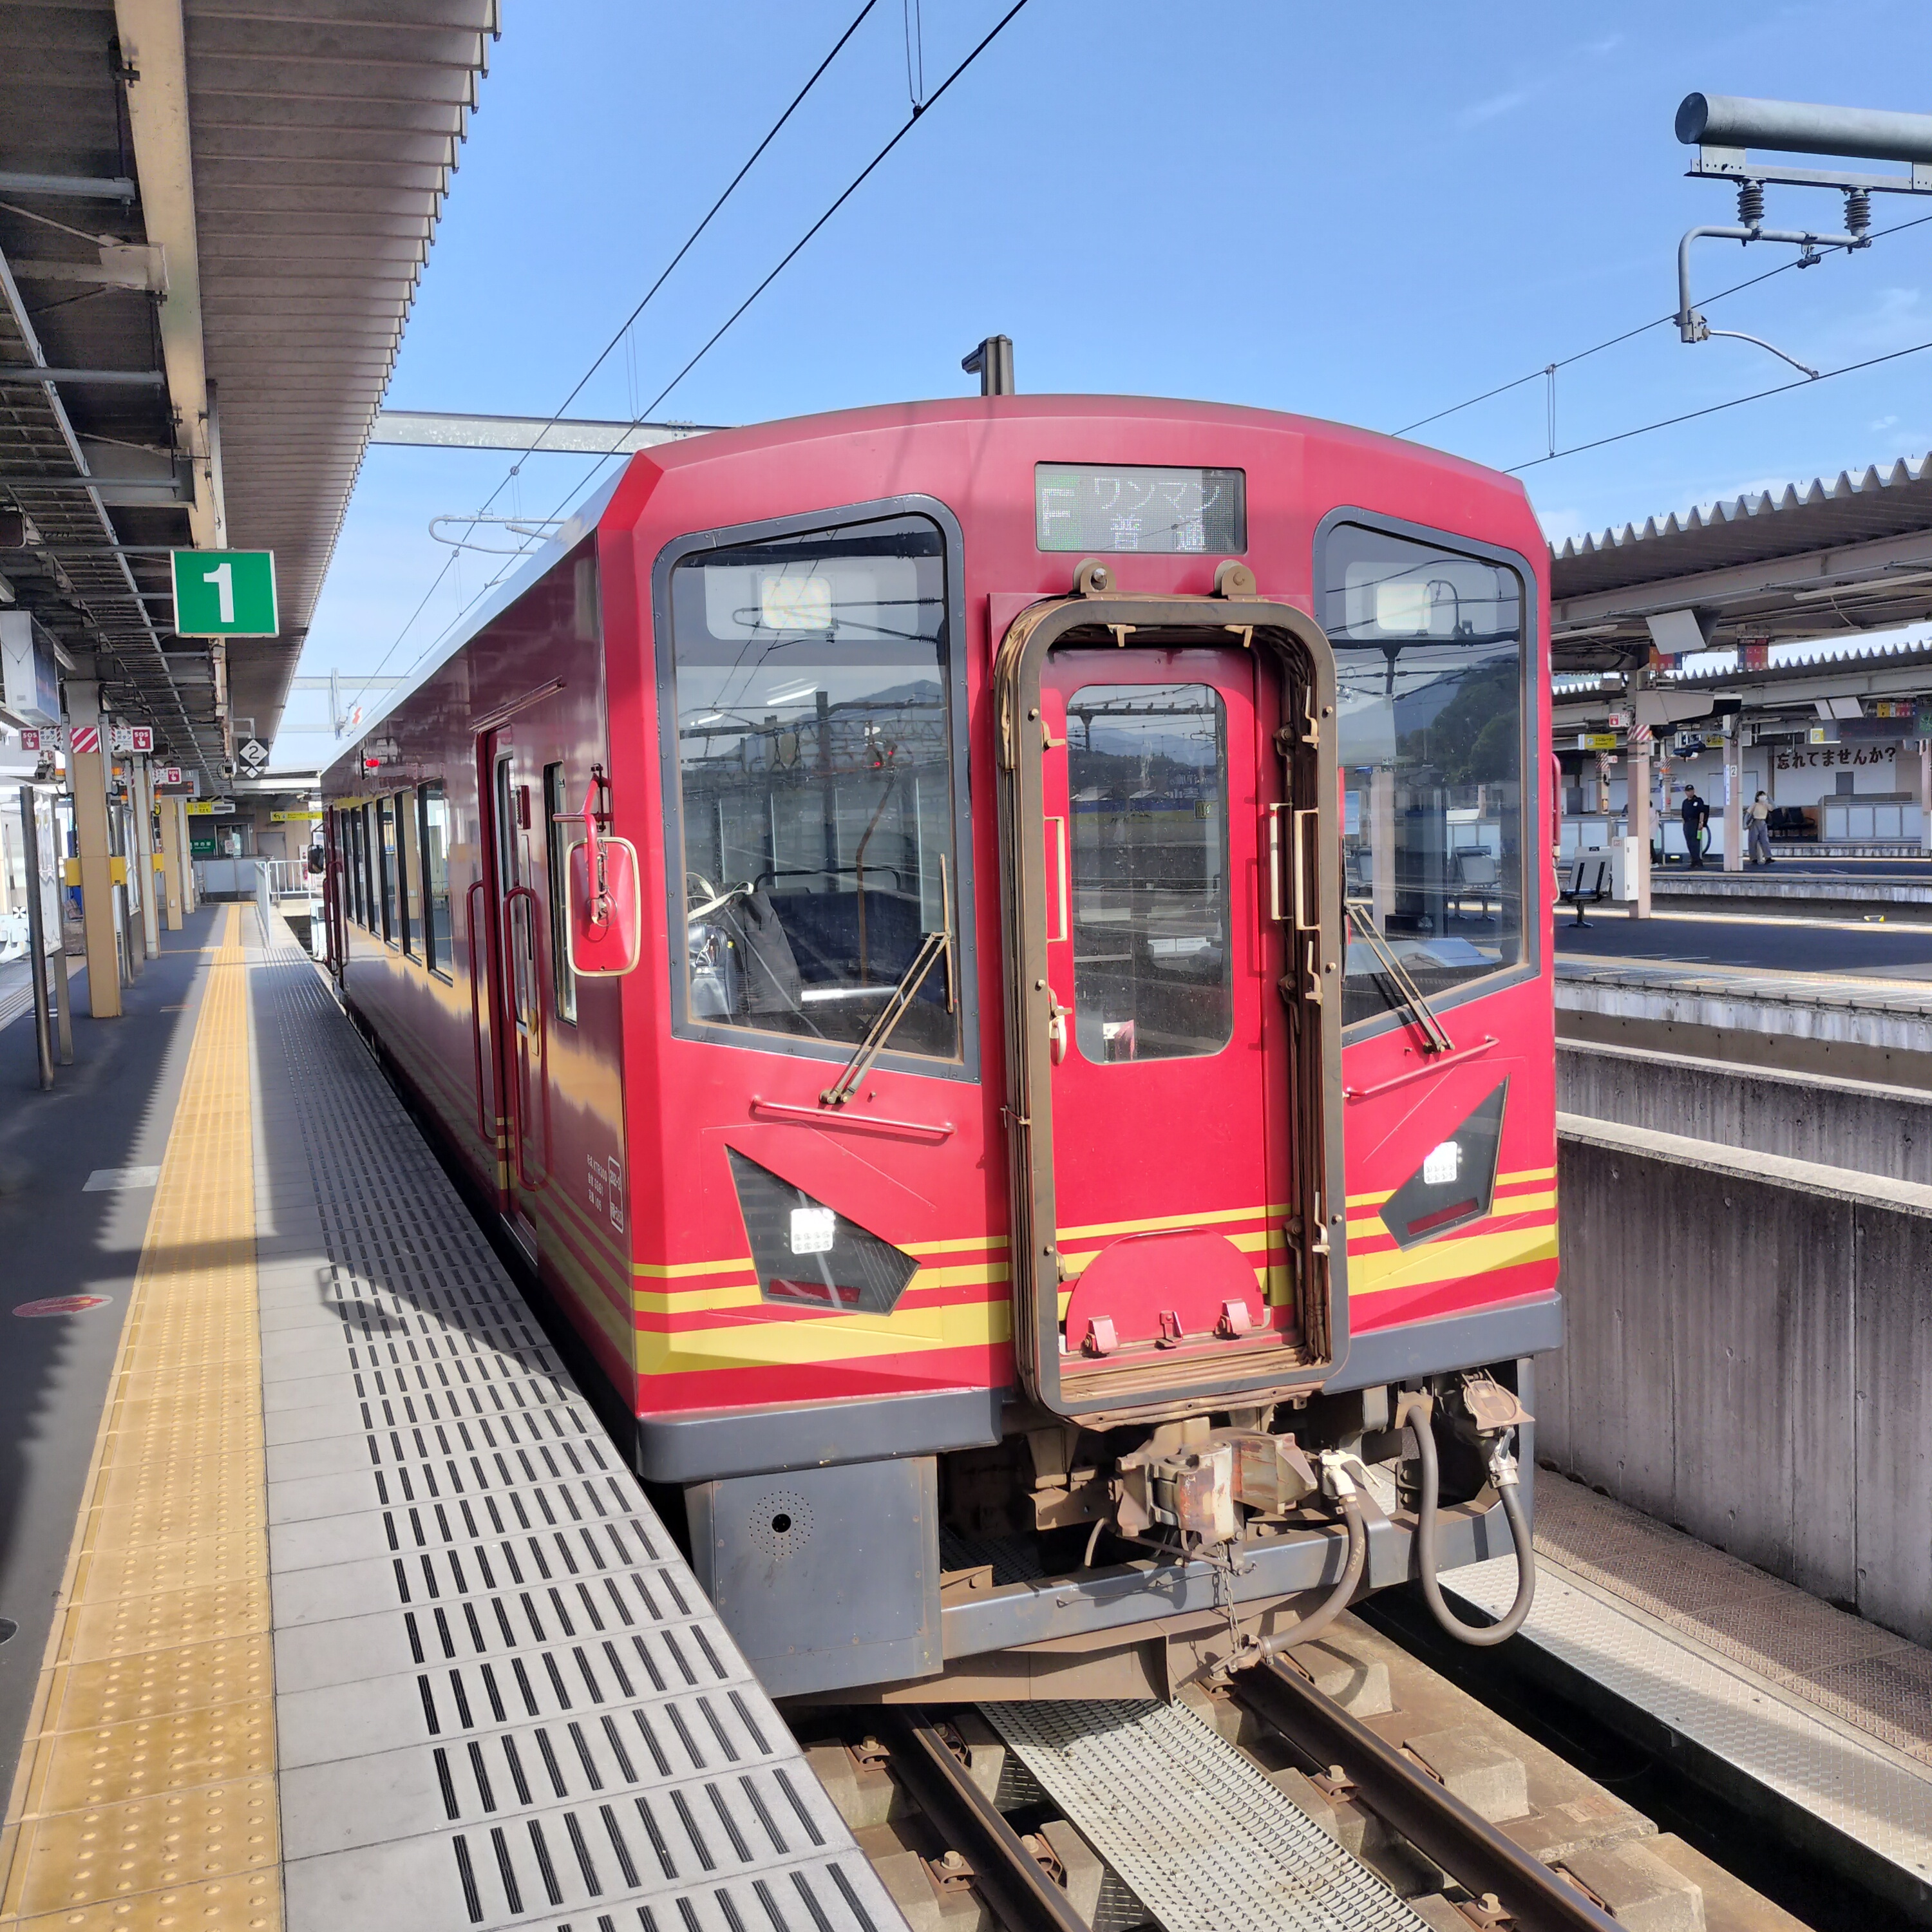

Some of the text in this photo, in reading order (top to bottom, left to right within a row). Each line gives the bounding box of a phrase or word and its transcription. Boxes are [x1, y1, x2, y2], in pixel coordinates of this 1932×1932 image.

[1094, 477, 1220, 511] ワンマン
[1042, 488, 1075, 535] F
[203, 563, 234, 623] 1
[249, 746, 260, 759] 2
[1776, 746, 1897, 770] 忘れてませんか?
[1731, 766, 1736, 775] 2
